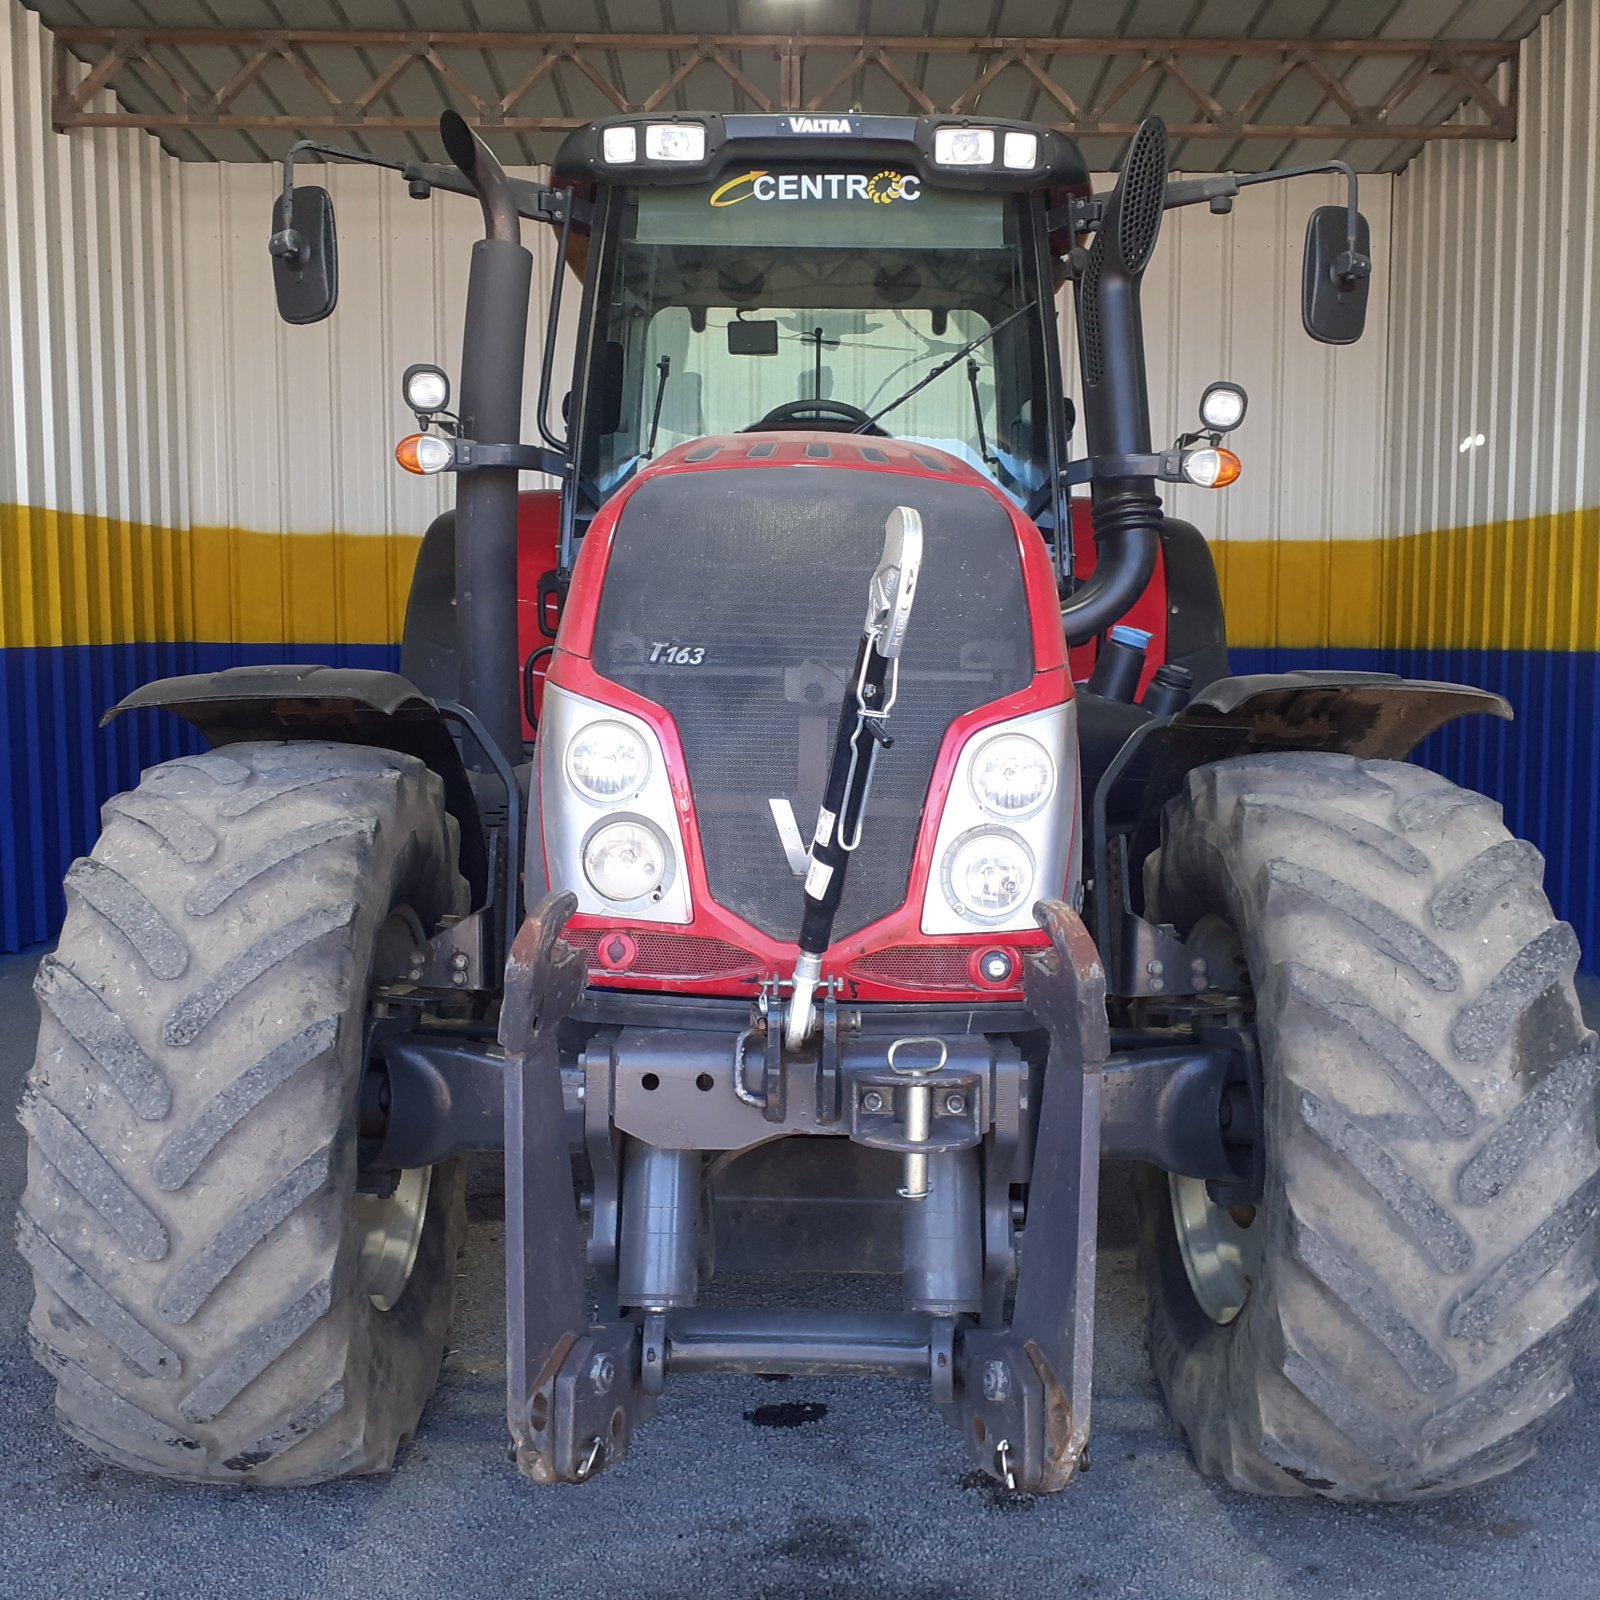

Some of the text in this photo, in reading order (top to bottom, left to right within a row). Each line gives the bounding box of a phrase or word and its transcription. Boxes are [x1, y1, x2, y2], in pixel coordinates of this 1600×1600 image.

[788, 116, 852, 134] VALTRA
[753, 171, 921, 204] CENTROC
[649, 642, 706, 665] T163
